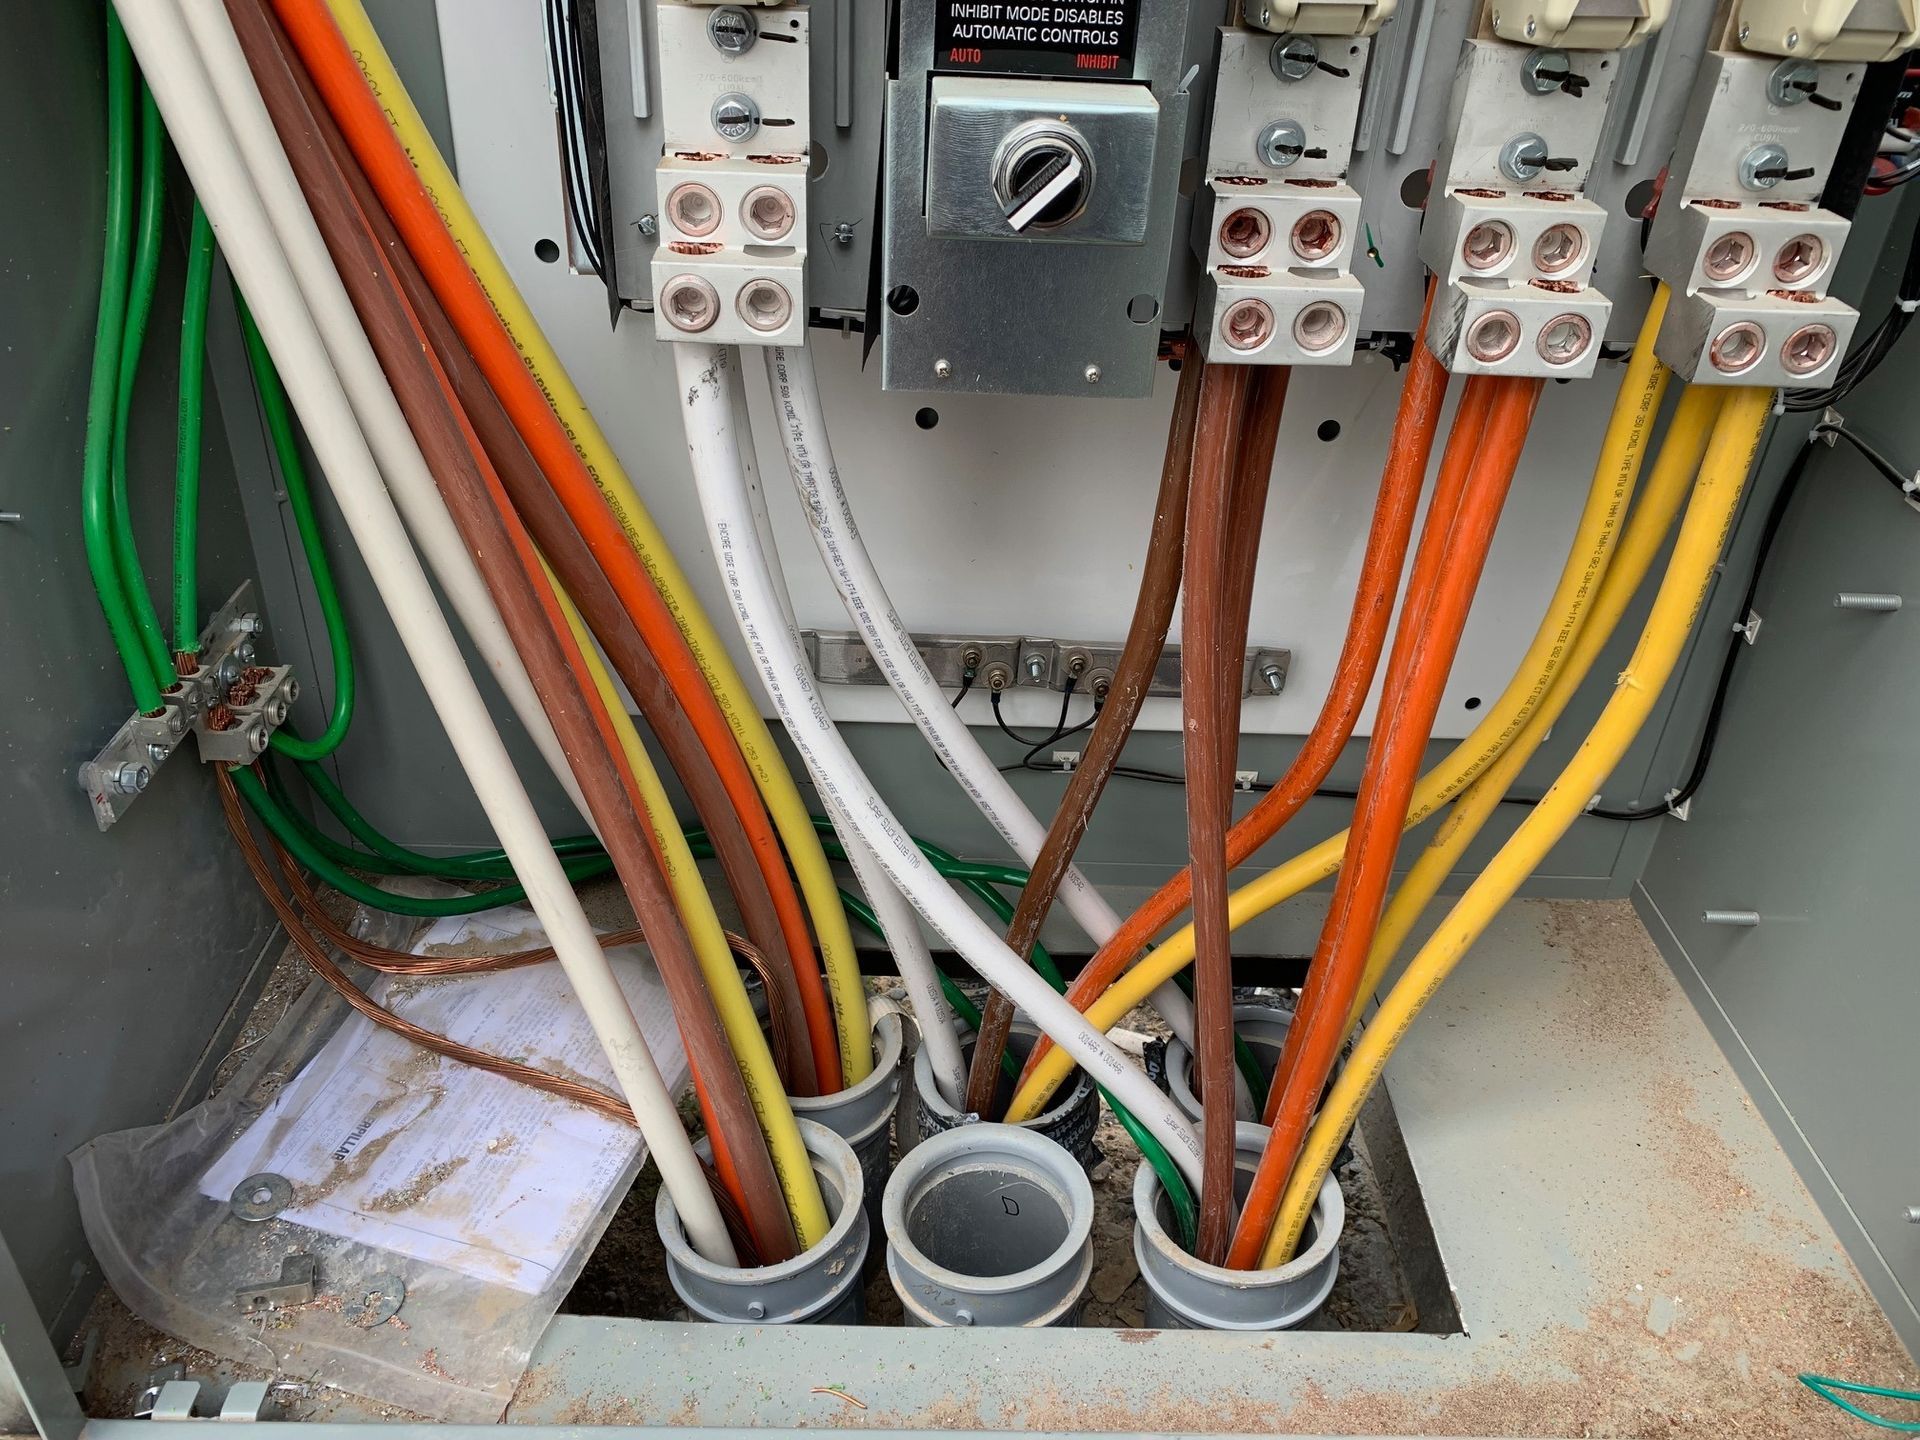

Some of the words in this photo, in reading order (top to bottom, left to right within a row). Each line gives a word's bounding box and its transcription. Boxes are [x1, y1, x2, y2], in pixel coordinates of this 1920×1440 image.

[951, 3, 1002, 19] INHIBIT
[1006, 5, 1050, 22] MODE
[1053, 8, 1124, 25] DISABLES
[952, 24, 1037, 41] AUTOMATIC
[1041, 27, 1119, 45] CONTROLS
[950, 47, 982, 63] AUTO
[1076, 53, 1119, 70] INHIBIT
[776, 363, 788, 383] CORP
[780, 384, 791, 399] 500
[783, 398, 796, 422] KCMIL
[1638, 391, 1653, 412] CORP
[1633, 413, 1645, 428] 350
[789, 422, 803, 443] TYPE
[795, 442, 808, 458] MTW
[799, 457, 811, 470] OR
[1620, 452, 1634, 472] TYPE
[717, 522, 730, 550] ENCORE
[723, 550, 734, 568] WIRE
[825, 538, 844, 568] SUN-RES
[1588, 555, 1600, 571] GR2
[727, 568, 739, 588] CORP
[1576, 569, 1594, 600] SUN-RES
[732, 587, 743, 602] 500
[844, 580, 857, 595] FT4
[851, 594, 864, 611] IEEE
[1563, 614, 1575, 629] FT4
[745, 622, 758, 642] TYPE
[1556, 627, 1570, 645] IEEE
[872, 636, 884, 650] FOR
[758, 654, 769, 666] OR
[877, 647, 889, 659] CT
[770, 681, 780, 693] OR
[1537, 672, 1549, 686] FOR
[792, 662, 812, 693] 001467
[809, 701, 830, 732] 001467
[1532, 684, 1543, 696] CT
[718, 693, 732, 710] 500
[727, 711, 745, 737] KCMIL
[910, 702, 924, 718] TYPE
[1486, 738, 1503, 755] TYPE
[863, 796, 885, 821] Super
[879, 817, 898, 839] Slick
[891, 835, 912, 857] Elite
[830, 977, 840, 992] FT
[1076, 1030, 1100, 1054] 001466
[1101, 1052, 1125, 1075] 001466
[736, 1058, 758, 1096] 00565
[751, 1099, 765, 1117] FT
[1161, 1113, 1181, 1133] Super
[1176, 1128, 1192, 1146] Slick
[783, 1191, 796, 1210] FT
